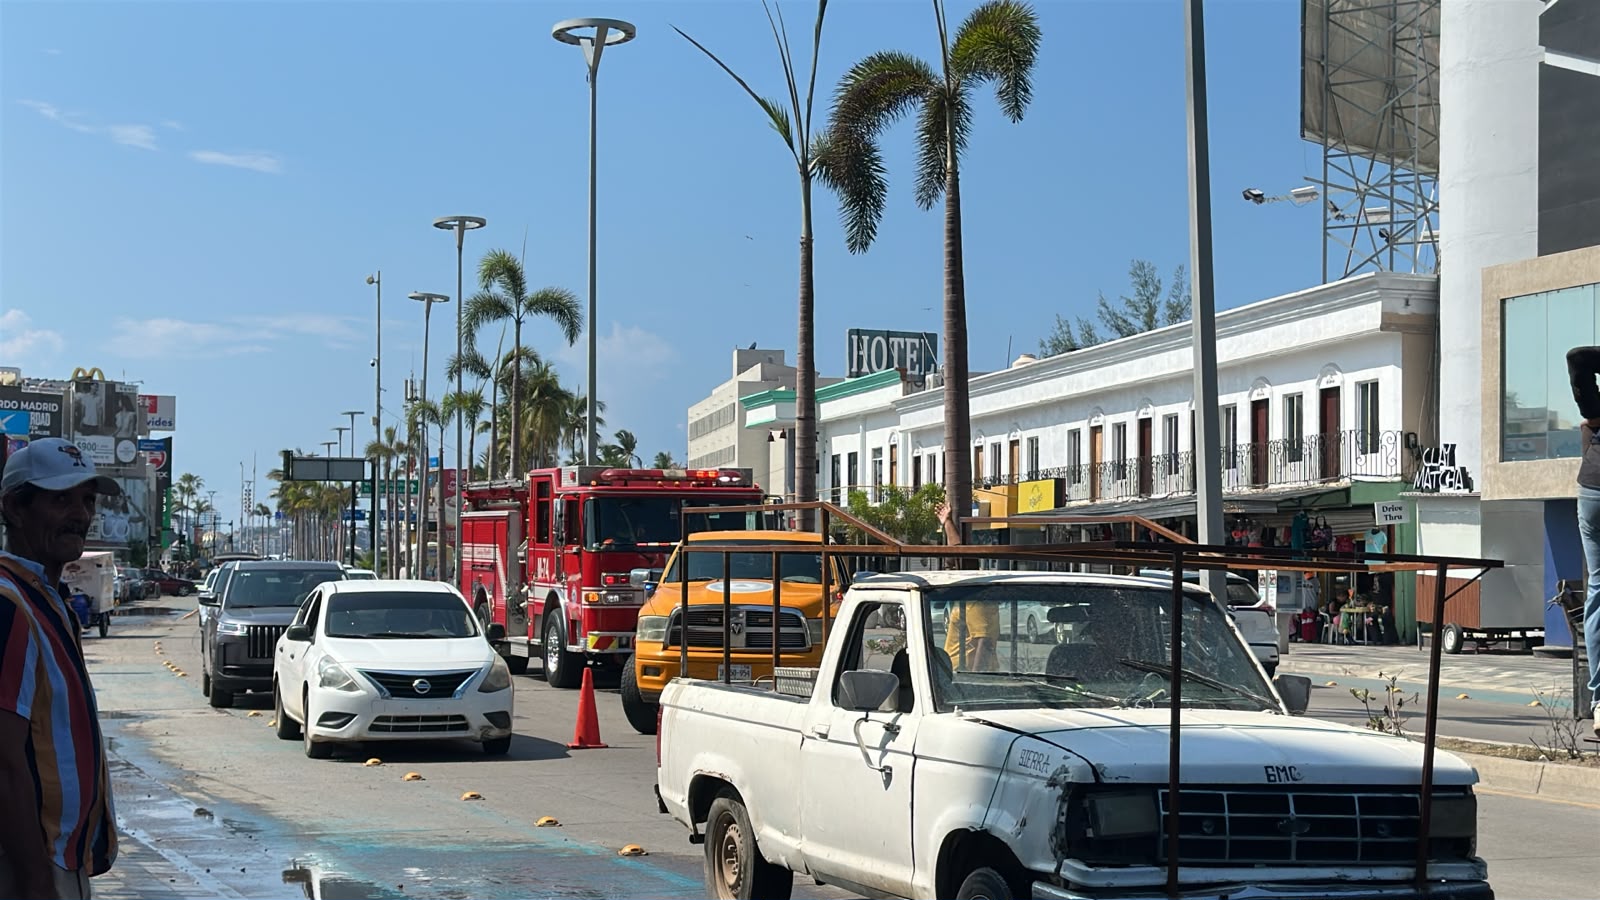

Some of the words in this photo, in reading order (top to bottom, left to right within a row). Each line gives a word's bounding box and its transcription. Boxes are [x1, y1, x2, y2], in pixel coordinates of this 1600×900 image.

[851, 334, 935, 375] HOTEL
[20, 401, 59, 412] MADRID
[1413, 466, 1464, 490] MATCHA
[1382, 505, 1403, 513] Drive
[1019, 749, 1051, 774] SIERRA
